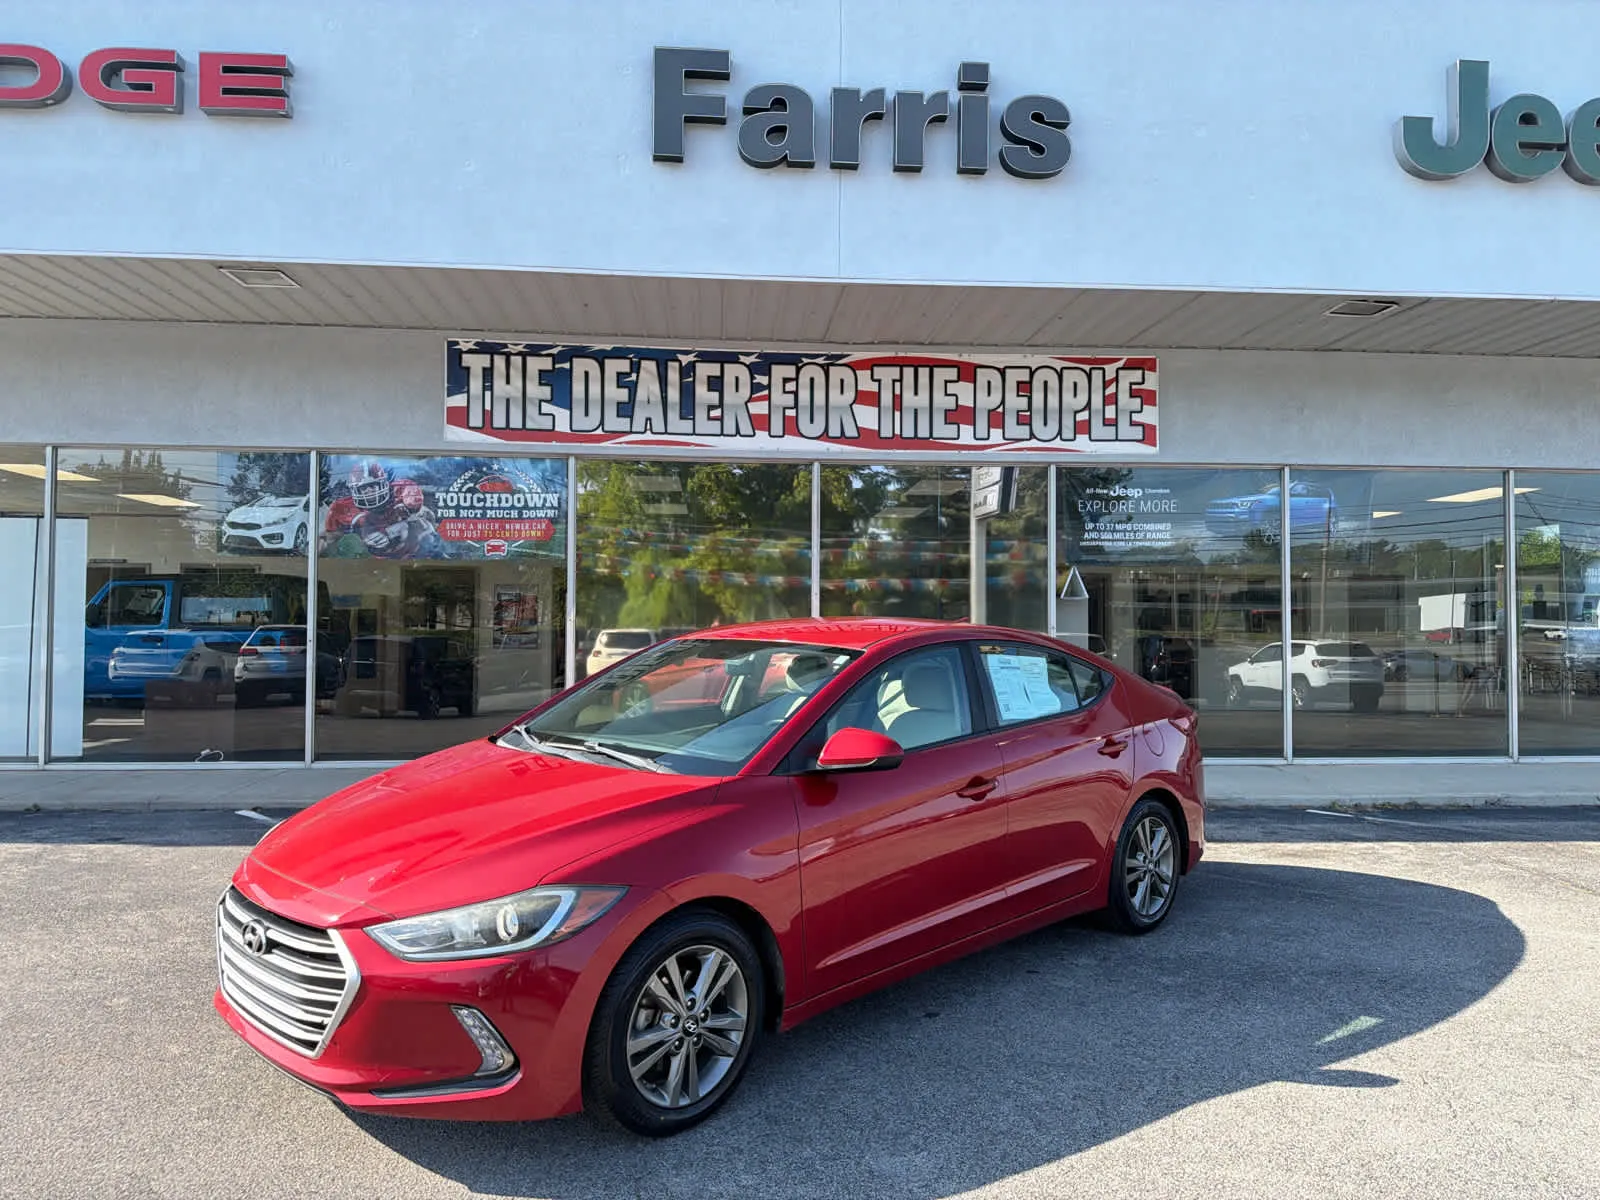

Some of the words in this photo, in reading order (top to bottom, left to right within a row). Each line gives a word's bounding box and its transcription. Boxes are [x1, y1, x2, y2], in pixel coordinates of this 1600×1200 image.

[652, 46, 1072, 179] Farris
[460, 353, 556, 431] THE
[569, 355, 756, 438] DEALER
[767, 361, 859, 439] FOR
[871, 364, 961, 440] THE
[974, 366, 1146, 442] PEOPLE
[1109, 485, 1143, 499] Jeep
[435, 492, 560, 508] TOUCHDOWN
[1078, 500, 1136, 513] EXPLORE
[1140, 500, 1178, 513] MORE
[437, 509, 456, 518] FOR
[460, 509, 482, 518] NOT
[486, 509, 519, 518] MUCH
[523, 509, 558, 518] DOWN!
[446, 522, 467, 530] DRIVE
[469, 522, 475, 530] A
[505, 522, 529, 530] NEWER
[1085, 522, 1095, 530] UP
[1115, 523, 1132, 531] MPG
[1133, 523, 1172, 531] COMBINED
[447, 529, 460, 538] FOR
[463, 529, 481, 538] JUST
[1083, 531, 1099, 539] AND
